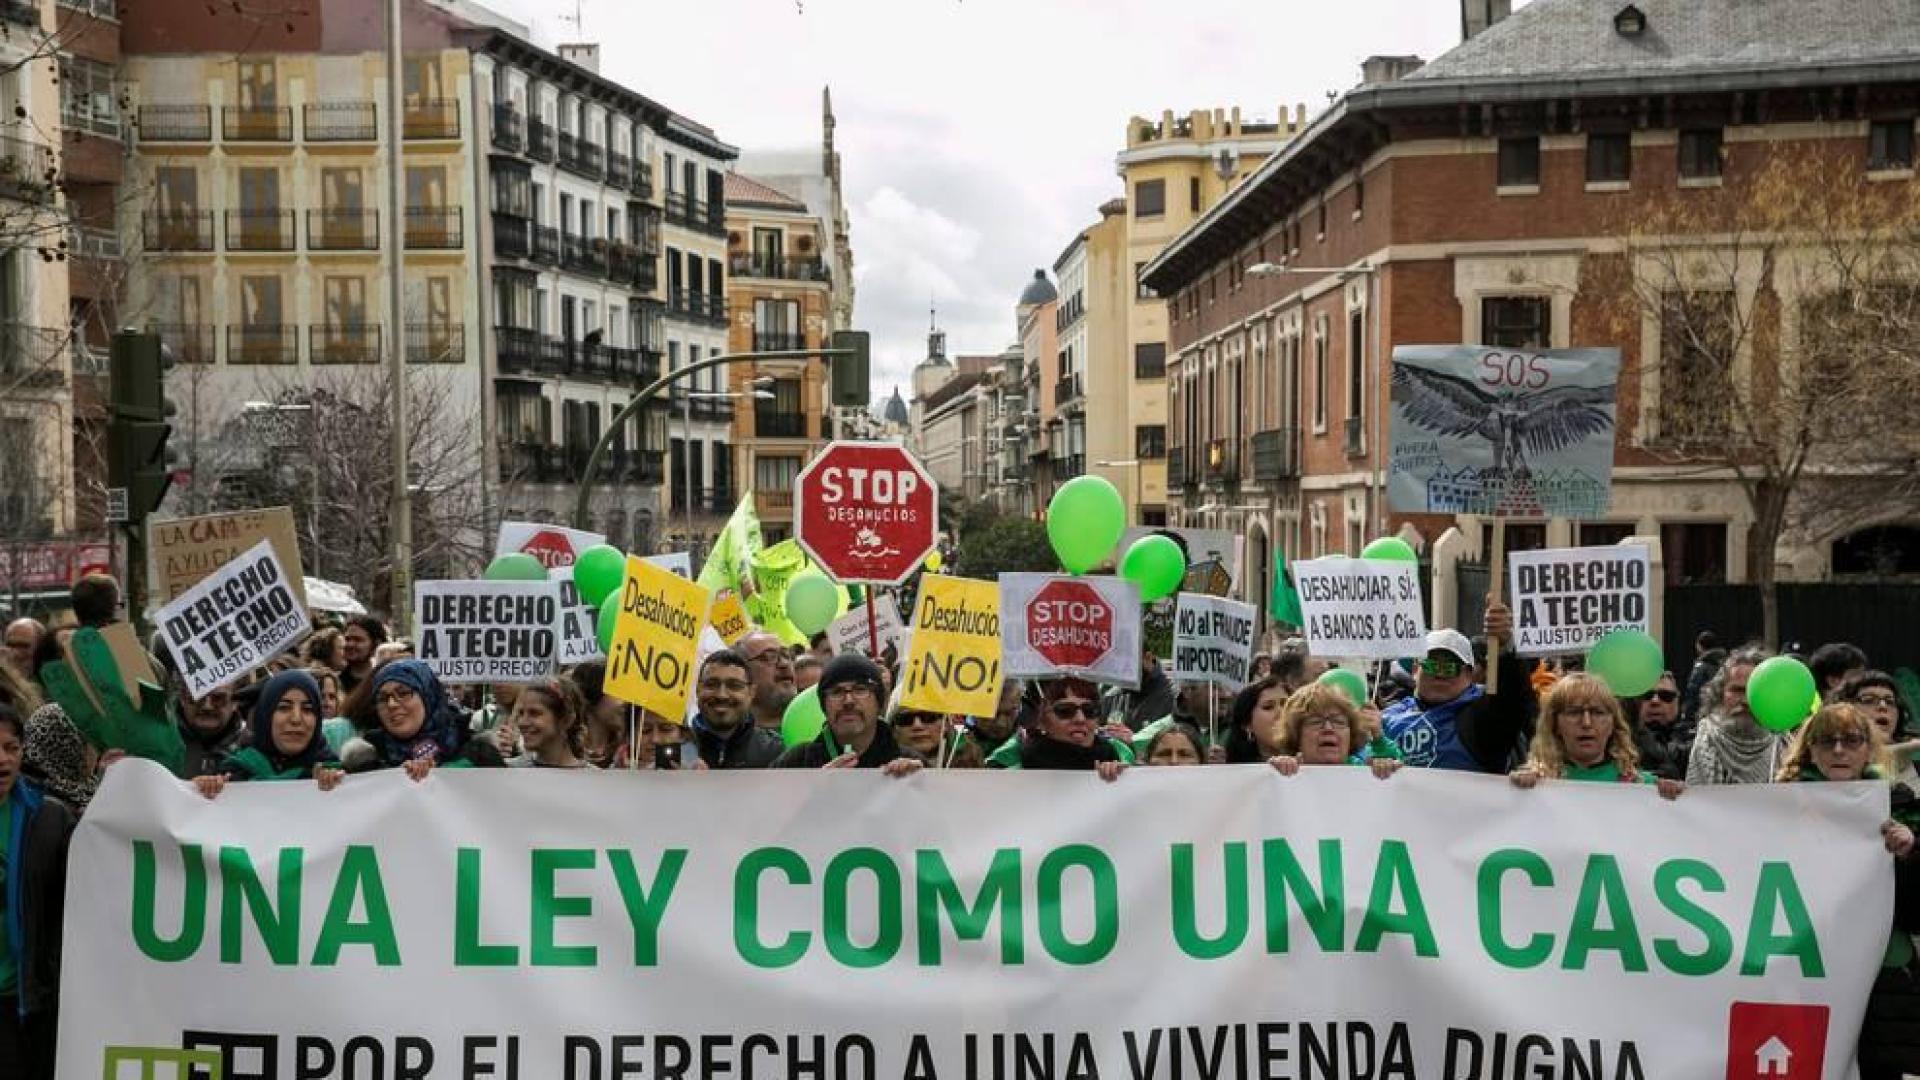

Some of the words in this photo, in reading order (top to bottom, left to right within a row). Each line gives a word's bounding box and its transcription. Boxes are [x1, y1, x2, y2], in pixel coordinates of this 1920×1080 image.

[821, 466, 918, 505] STOP
[827, 507, 917, 522] DESAHUCIOS
[160, 526, 186, 545] LA
[1518, 559, 1645, 594] DERECHO
[165, 556, 278, 647] DERECHO
[421, 594, 555, 625] DERECHO
[623, 576, 698, 640] Desahucios
[920, 595, 1000, 637] Desahucio
[1033, 600, 1106, 625] STOP
[1520, 598, 1539, 628] A
[1543, 592, 1645, 626] TECHO
[182, 646, 206, 676] A
[201, 585, 294, 660] TECHO
[420, 628, 439, 659] A
[444, 627, 554, 659] TECHO
[563, 612, 582, 641] A
[1032, 626, 1109, 651] DESAHUCIOS
[1178, 608, 1196, 635] NO
[1198, 610, 1210, 636] al
[1213, 612, 1252, 646] FRAUDE
[1310, 616, 1322, 639] A
[1322, 614, 1374, 641] BANCOS
[1378, 615, 1390, 637] &
[1520, 631, 1531, 647] A
[1535, 627, 1583, 645] JUSTO
[193, 675, 206, 692] A
[208, 646, 254, 684] JUSTO
[436, 660, 485, 676] JUSTO
[611, 638, 690, 698] ¡NO!
[907, 651, 998, 694] ¡NO!
[1403, 728, 1431, 753] OP
[131, 839, 401, 966] UNA
[453, 847, 689, 967] LEY
[732, 844, 1119, 968] COMO
[1170, 837, 1439, 959] UNA
[1476, 847, 1826, 979] CASA
[296, 1034, 434, 1080] POR
[563, 1033, 877, 1080] DERECHO
[902, 1034, 939, 1080] A
[965, 1032, 1102, 1080] UNA
[1122, 1021, 1418, 1080] VIVIENDA
[1443, 1027, 1648, 1080] DIGNA
